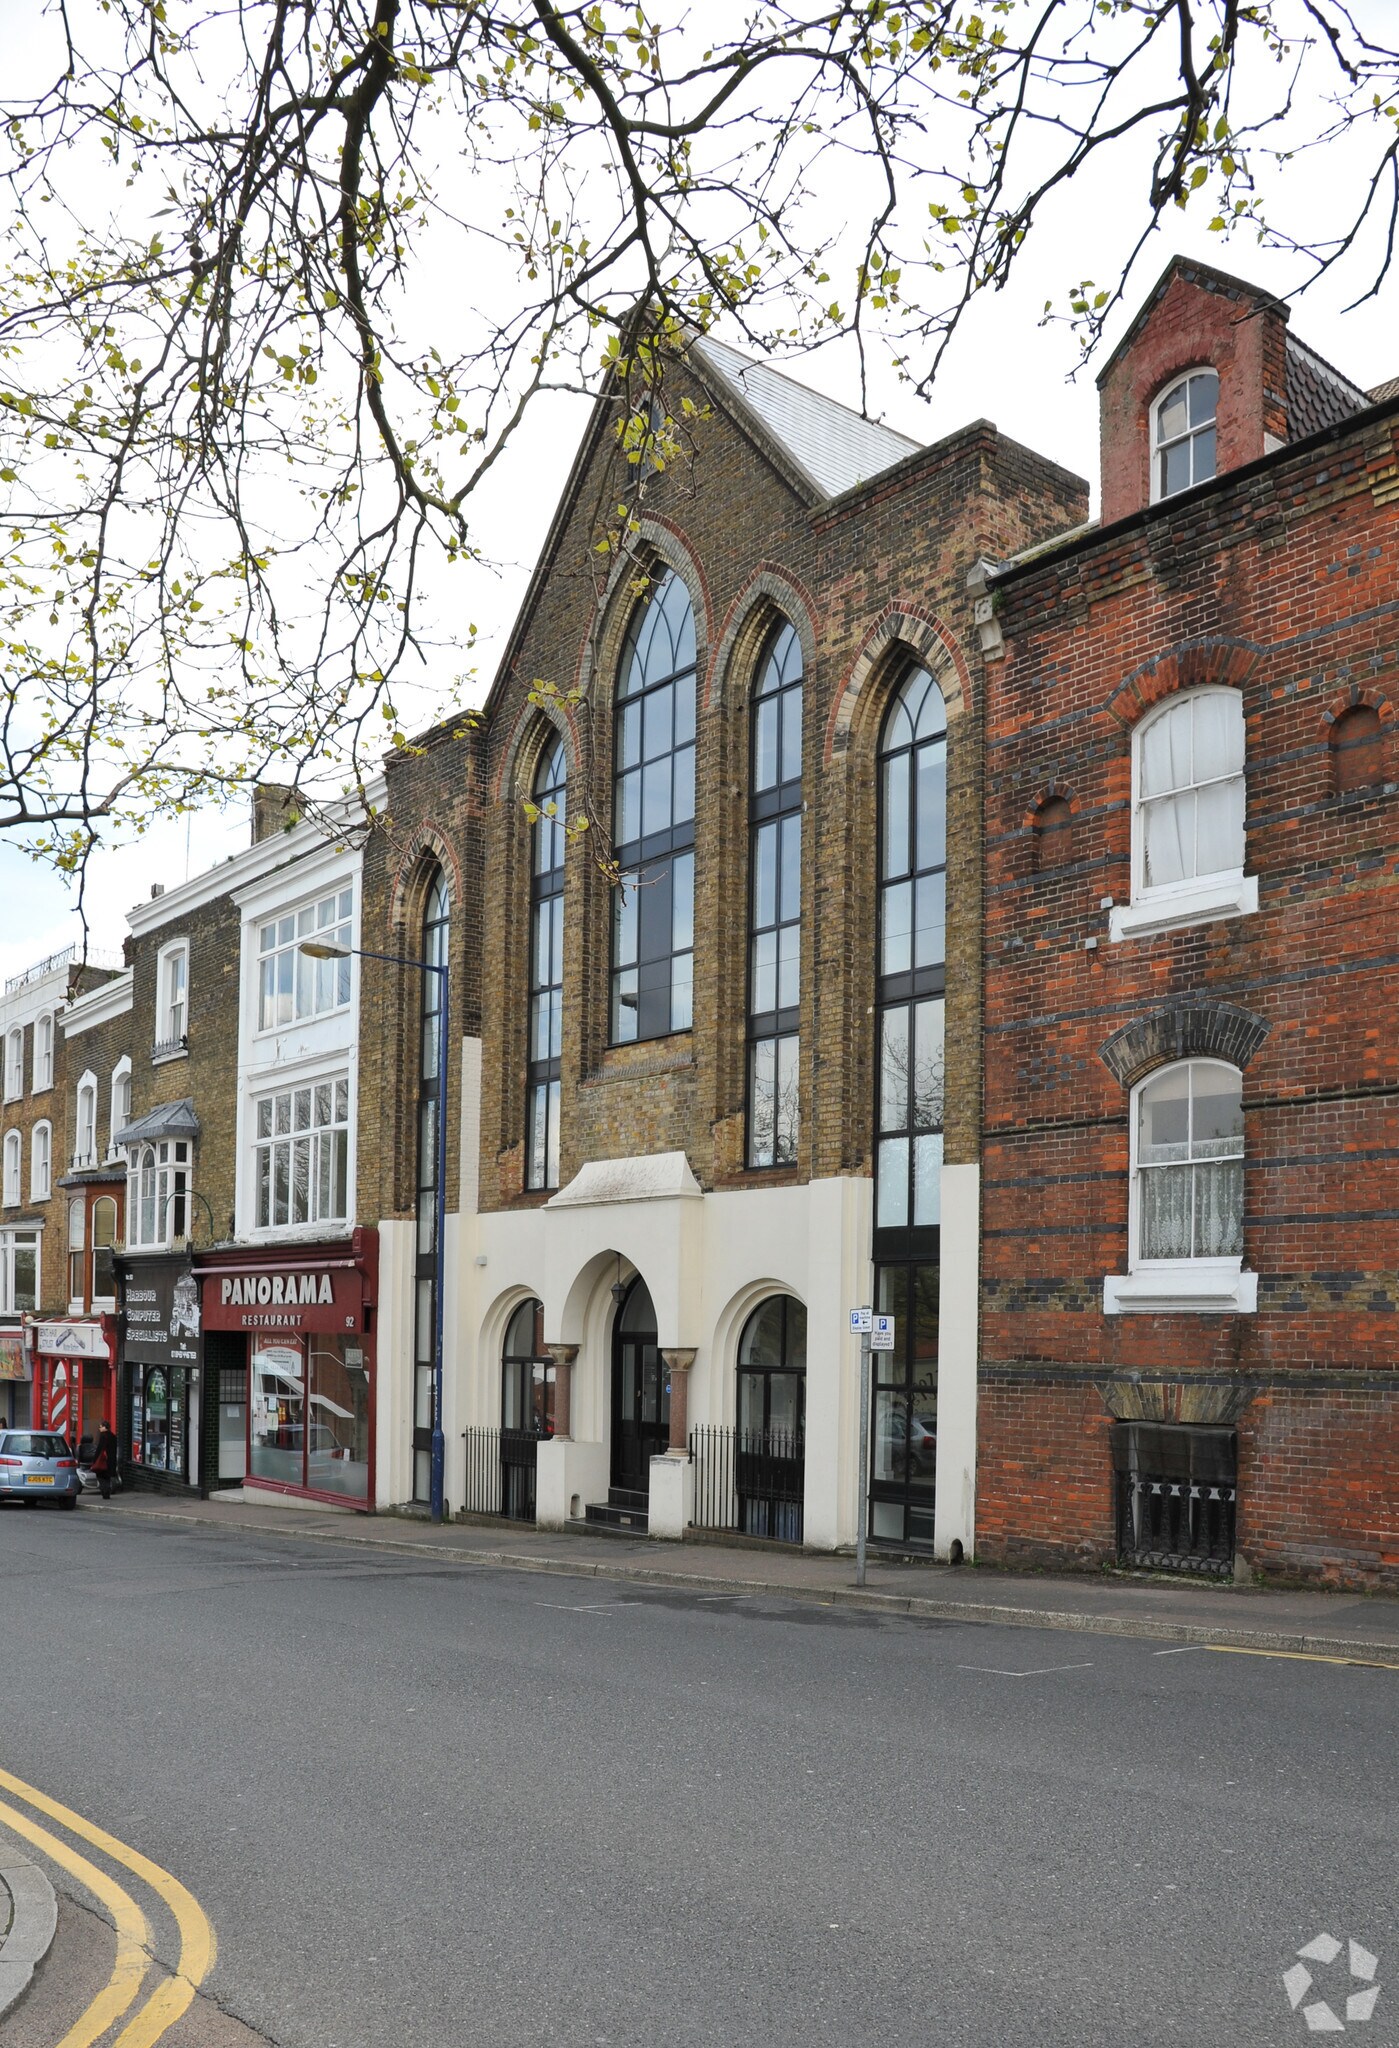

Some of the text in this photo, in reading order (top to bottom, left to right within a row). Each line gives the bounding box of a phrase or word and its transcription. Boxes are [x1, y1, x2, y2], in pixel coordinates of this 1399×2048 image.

[126, 1289, 156, 1302] HARBOUR
[221, 1274, 333, 1305] PANORAMA
[127, 1308, 161, 1322] COMPUTER
[241, 1315, 302, 1326] RESTAURANT
[345, 1316, 355, 1328] 92
[126, 1328, 168, 1343] SPECIALISTS
